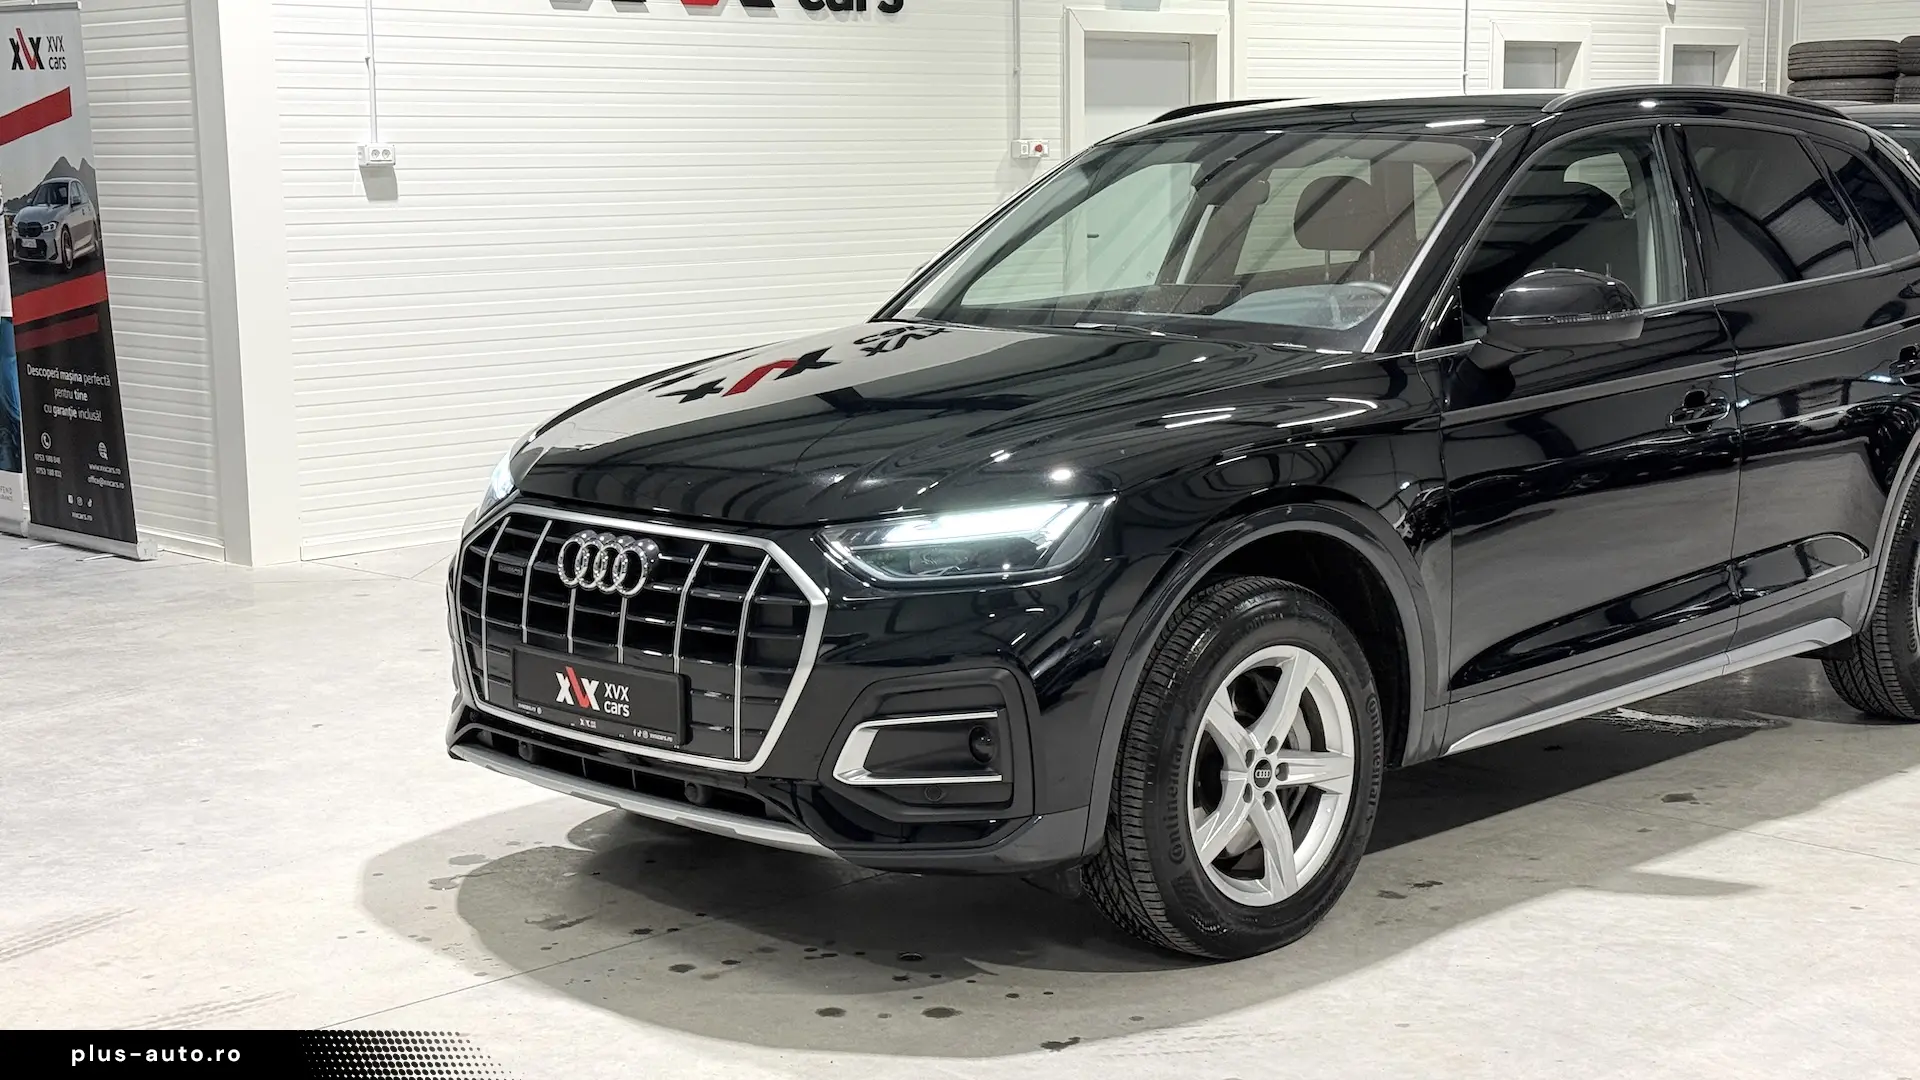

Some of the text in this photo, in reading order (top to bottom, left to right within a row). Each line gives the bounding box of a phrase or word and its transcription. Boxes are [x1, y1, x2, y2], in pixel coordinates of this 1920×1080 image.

[46, 36, 65, 52] XVX
[48, 56, 67, 70] cars
[27, 364, 59, 380] Descoperă
[83, 372, 111, 387] perfectă
[54, 388, 88, 401] pentru tine
[43, 404, 52, 414] cu
[604, 682, 630, 702] XVX
[604, 700, 630, 718] cars
